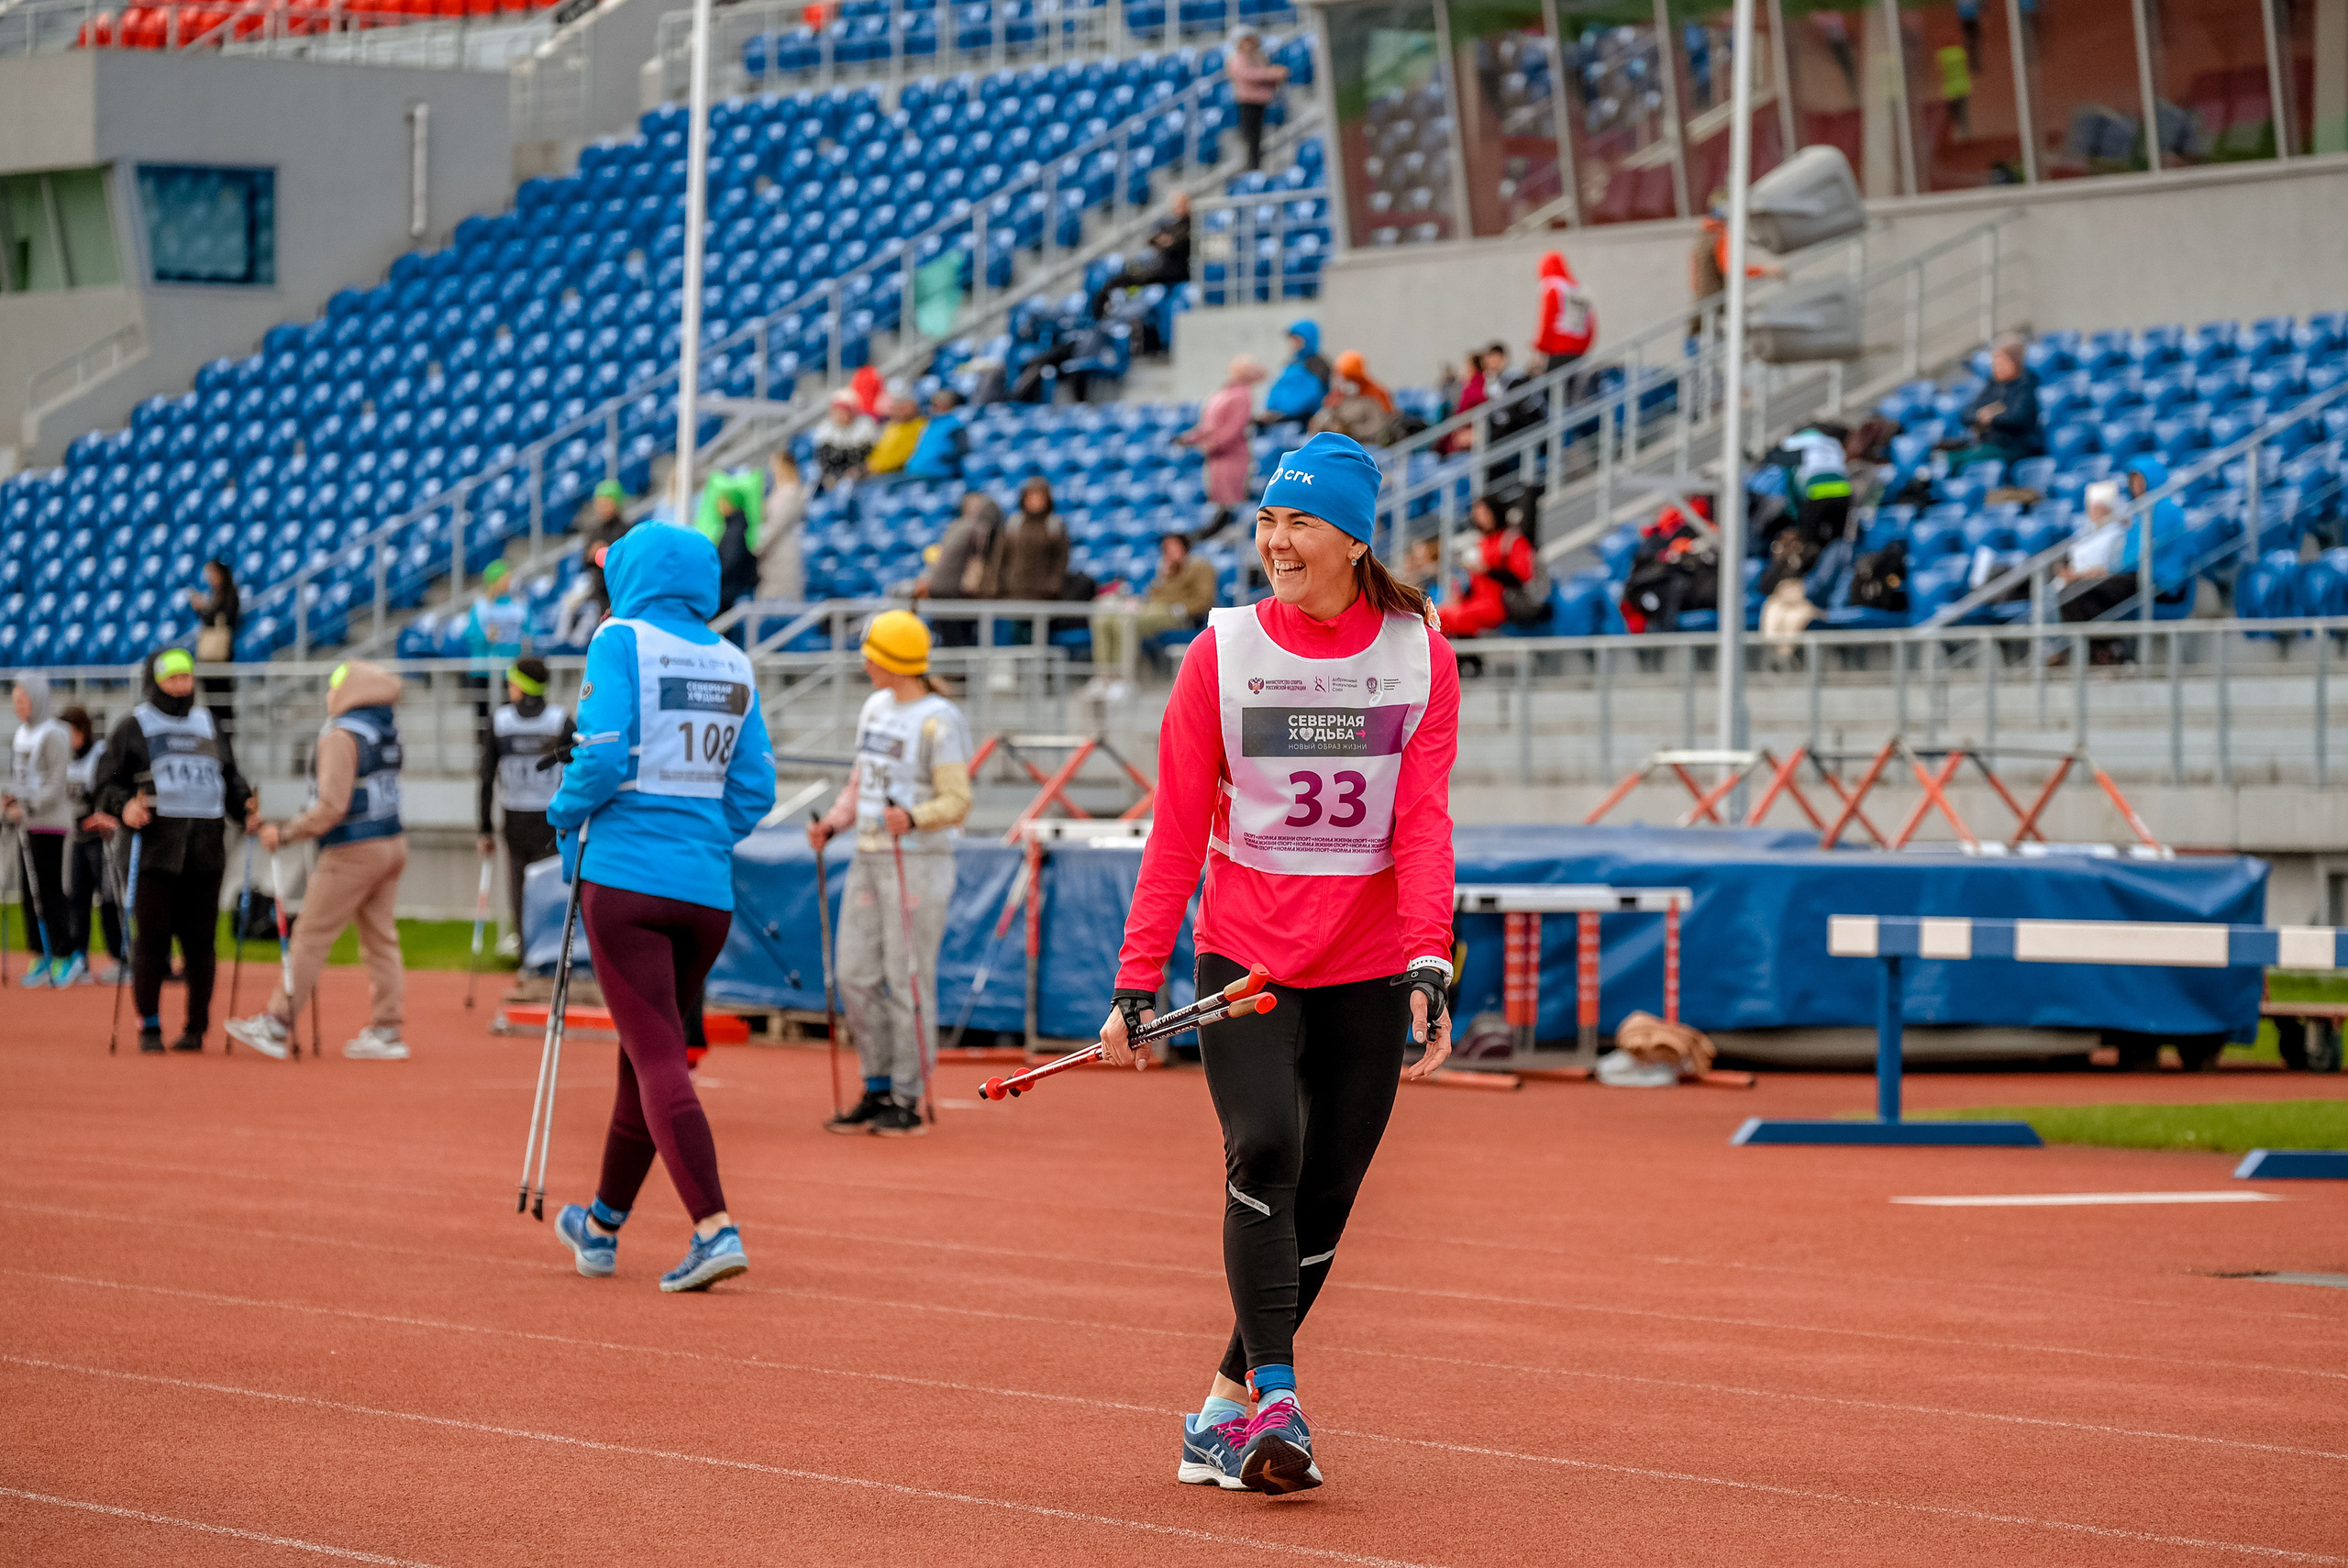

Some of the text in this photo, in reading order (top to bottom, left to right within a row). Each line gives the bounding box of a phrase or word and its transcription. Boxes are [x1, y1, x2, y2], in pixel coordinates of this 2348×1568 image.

[1284, 469, 1315, 486] СГК
[1288, 715, 1365, 727] СЕВЕРНАЯ
[679, 722, 735, 765] 108
[1284, 770, 1368, 828] 33
